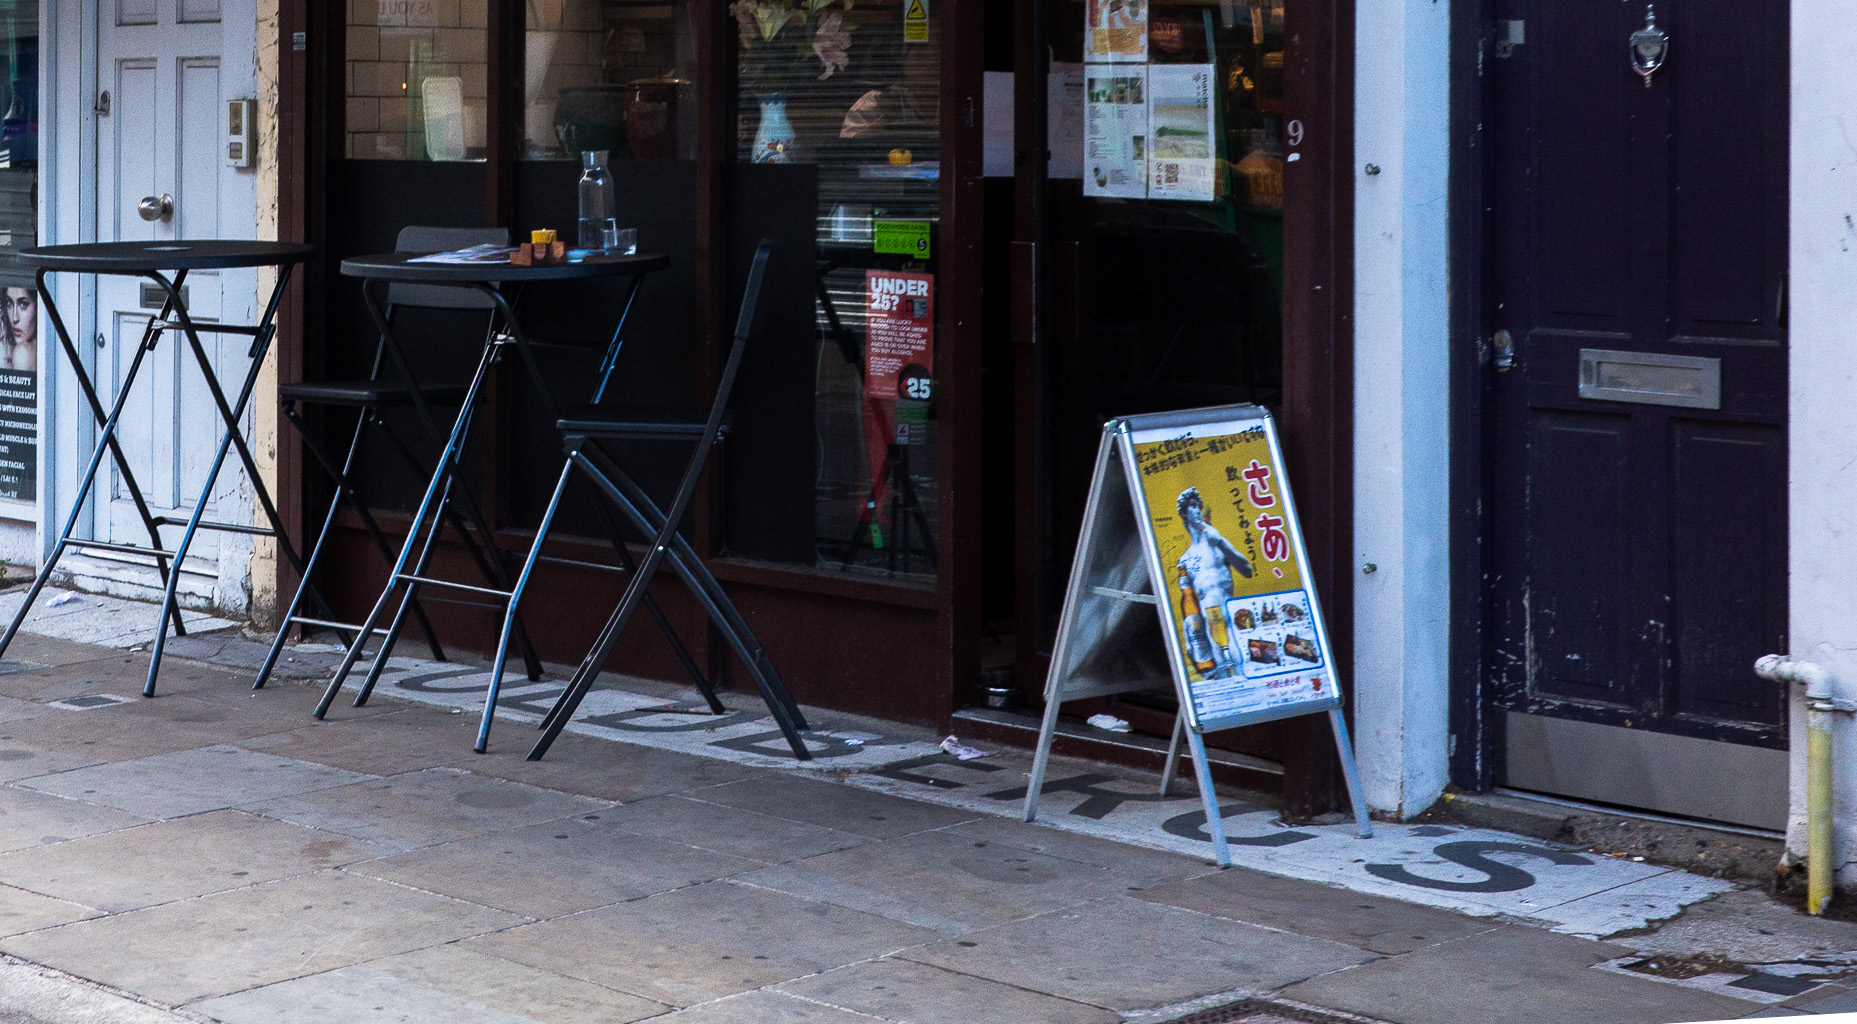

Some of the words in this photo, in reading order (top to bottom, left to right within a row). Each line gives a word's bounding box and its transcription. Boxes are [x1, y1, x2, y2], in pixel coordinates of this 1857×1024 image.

[1287, 119, 1304, 146] 9
[871, 277, 929, 296] UNDER
[871, 293, 900, 311] 25?
[907, 377, 931, 399] 25
